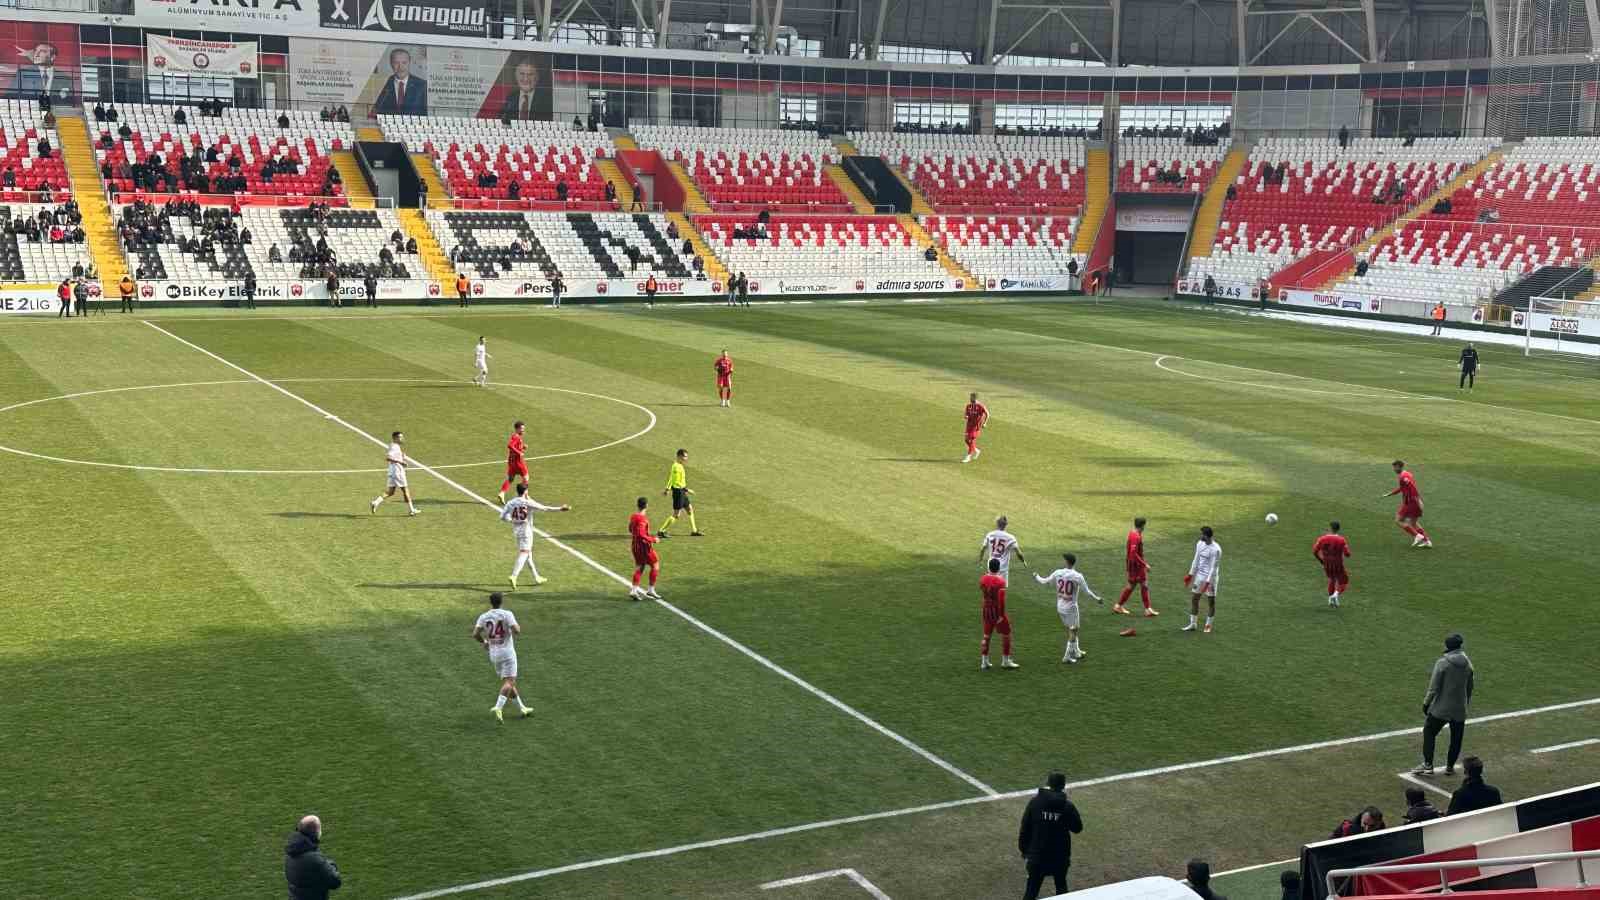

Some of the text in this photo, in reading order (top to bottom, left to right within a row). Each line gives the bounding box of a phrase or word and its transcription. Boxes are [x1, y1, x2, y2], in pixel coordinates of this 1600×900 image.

[392, 5, 485, 26] anagold
[183, 286, 225, 298] BiKey
[876, 280, 945, 291] admira sports
[511, 506, 527, 520] 45
[990, 538, 1006, 554] 15
[1057, 579, 1074, 595] 20
[486, 620, 505, 639] 24
